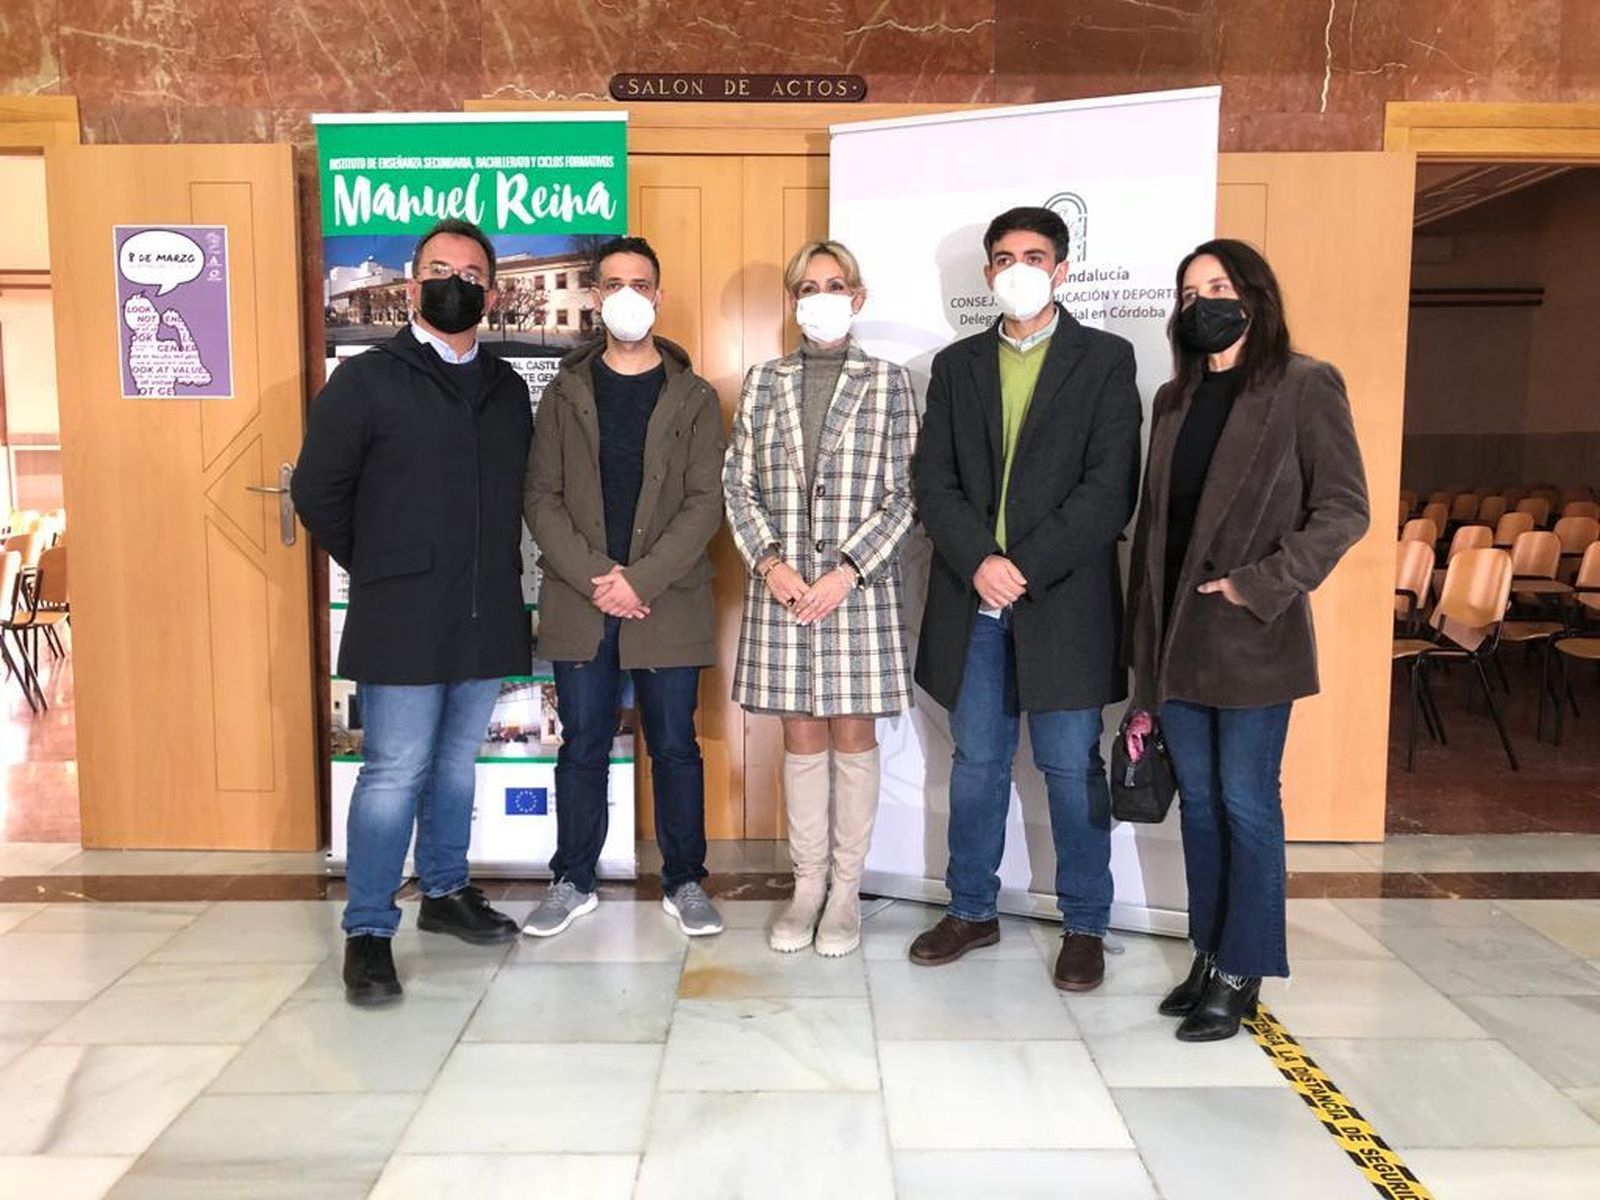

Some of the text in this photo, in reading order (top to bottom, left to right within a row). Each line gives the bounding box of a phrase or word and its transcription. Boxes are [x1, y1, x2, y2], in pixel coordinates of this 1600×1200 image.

[628, 79, 848, 96] SALON DE ACTOS
[367, 157, 378, 169] DE
[530, 155, 537, 168] Y
[334, 170, 617, 229] Manuel Reina
[138, 254, 152, 263] DE
[156, 254, 195, 263] MARZO
[1065, 265, 1130, 283] ndalucía
[1053, 289, 1110, 303] UCACIÓN
[1112, 289, 1120, 300] Y
[127, 306, 151, 314] LOOK
[1092, 309, 1107, 319] en
[1110, 305, 1165, 318] Córdoba
[137, 315, 157, 323] NOT
[156, 366, 169, 374] AT
[1276, 1050, 1300, 1062] LA
[1290, 1067, 1349, 1120] DISTANCIA
[1341, 1127, 1369, 1141] DE
